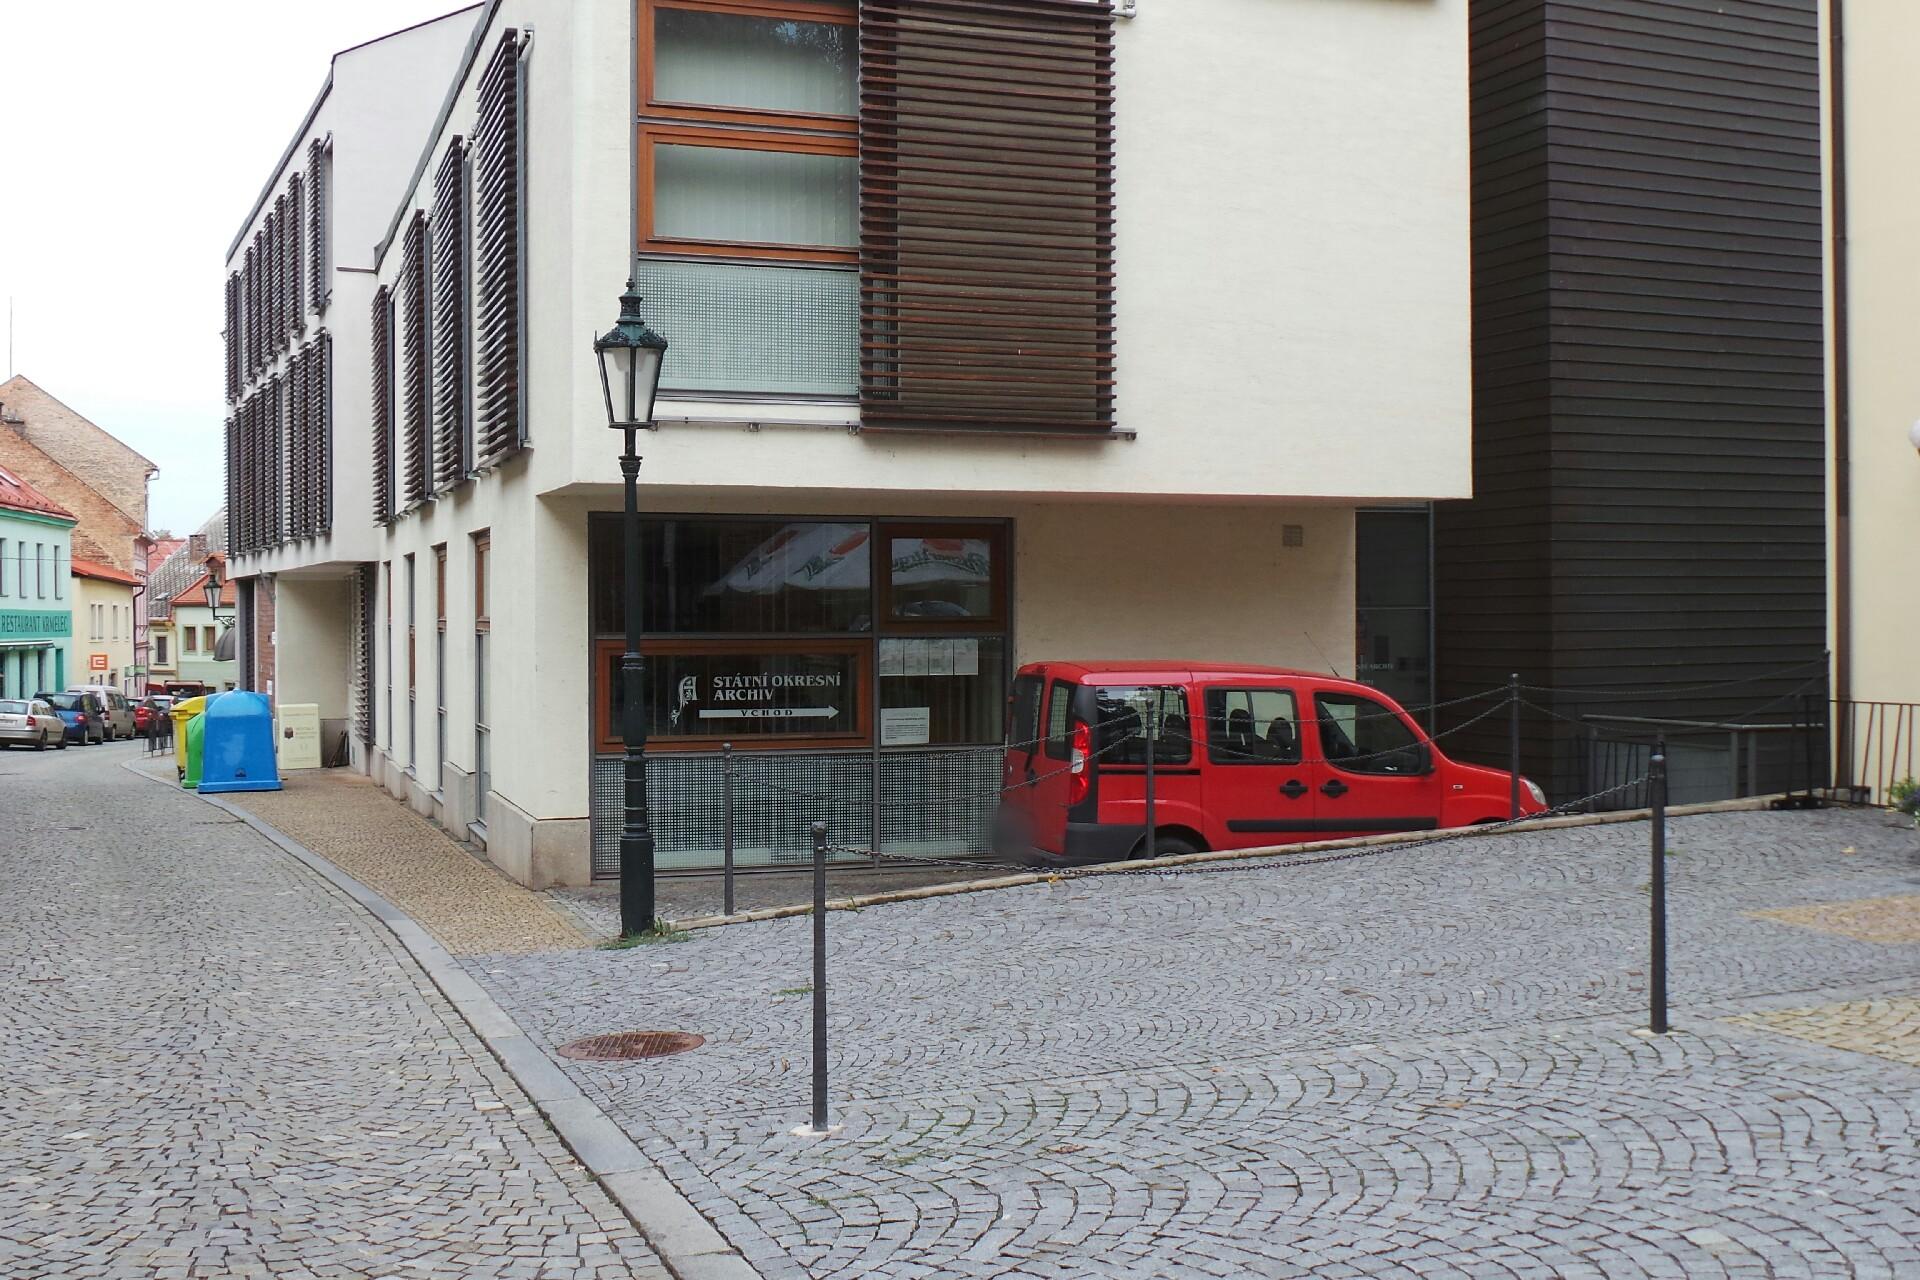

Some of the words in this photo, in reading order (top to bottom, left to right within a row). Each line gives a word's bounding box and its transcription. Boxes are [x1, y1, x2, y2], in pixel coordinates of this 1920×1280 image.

[1, 615, 41, 632] RESTAURANT
[713, 672, 768, 688] STÁTNÍ
[771, 672, 841, 687] OKRESNÍ
[713, 688, 774, 701] ARCHIV
